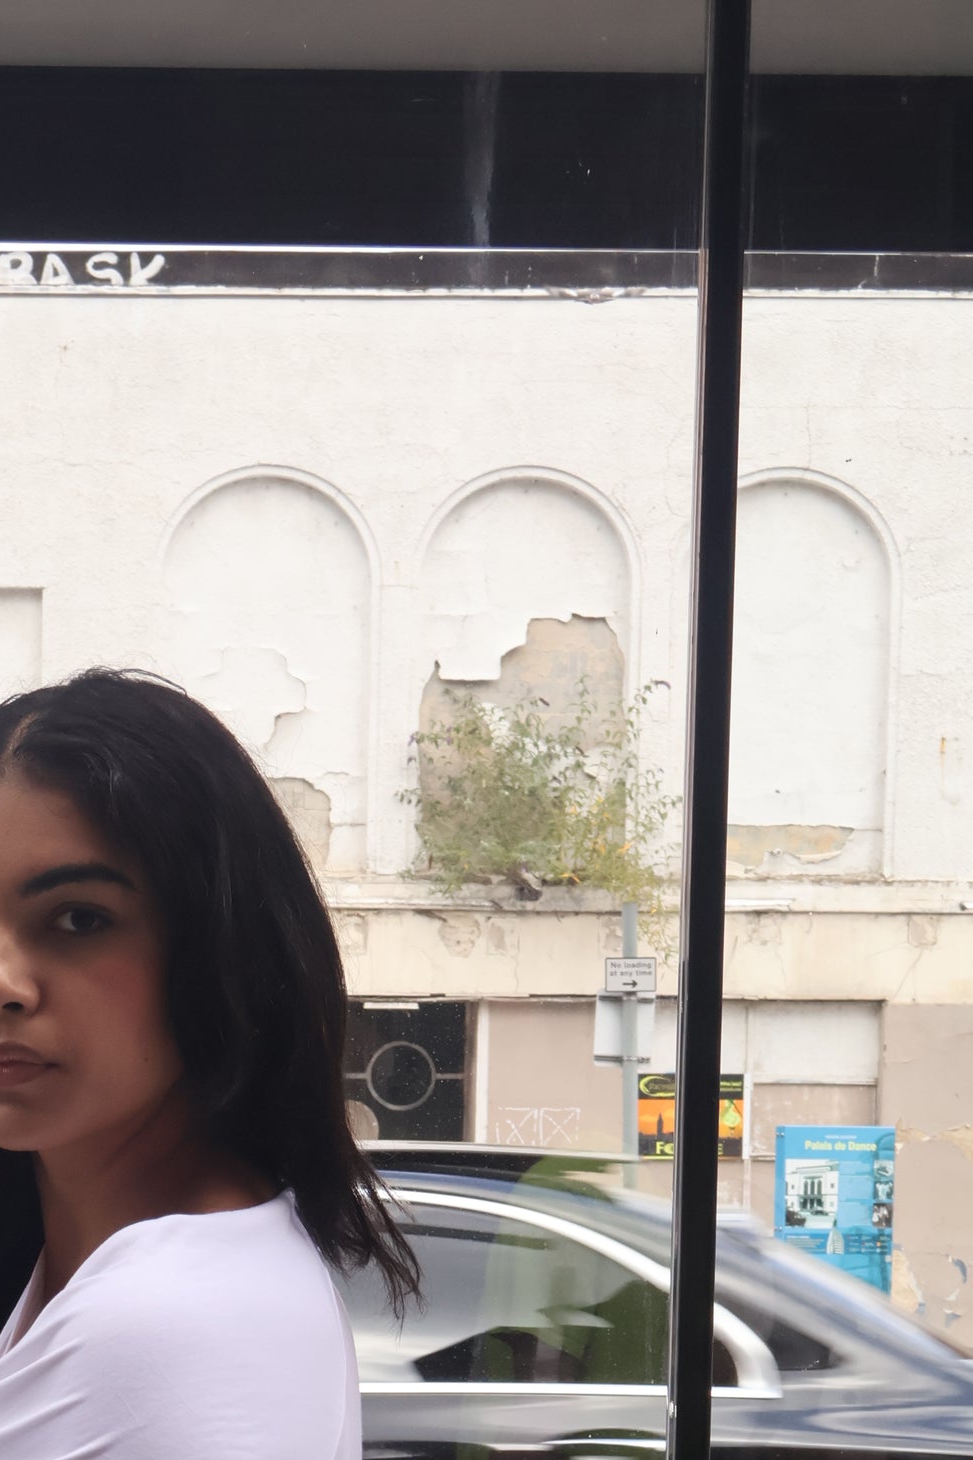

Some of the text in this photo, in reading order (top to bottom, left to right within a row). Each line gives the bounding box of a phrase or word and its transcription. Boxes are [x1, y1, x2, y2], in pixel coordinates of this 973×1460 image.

[610, 961, 653, 971] No loading
[805, 1140, 833, 1151] Palais
